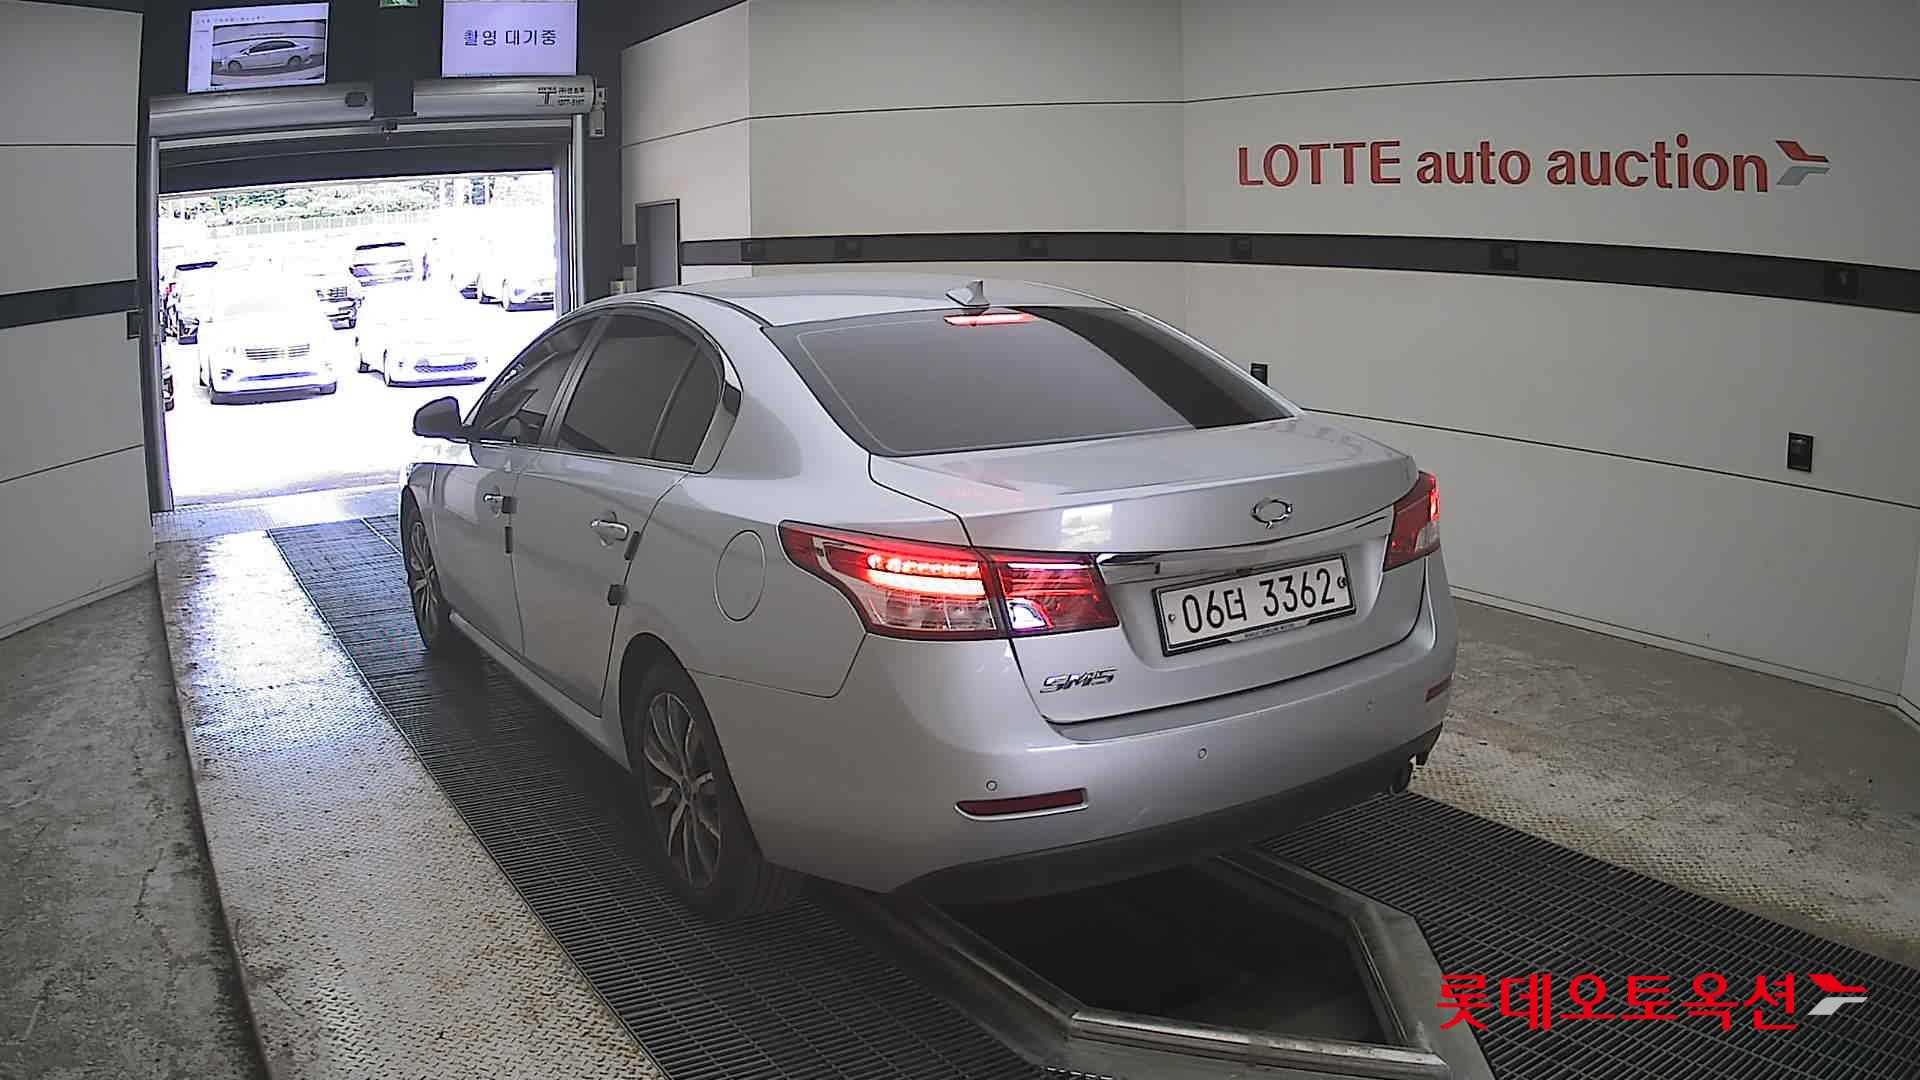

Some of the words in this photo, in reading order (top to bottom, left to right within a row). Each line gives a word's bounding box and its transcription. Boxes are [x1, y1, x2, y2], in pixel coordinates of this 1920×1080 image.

[505, 29, 558, 47] 대기중
[1238, 140, 1401, 187] LOTTE
[1416, 140, 1531, 185] auto
[1547, 133, 1768, 192] auction
[1182, 587, 1248, 634] 06더
[1259, 568, 1336, 617] 3362
[1040, 668, 1118, 694] SM5
